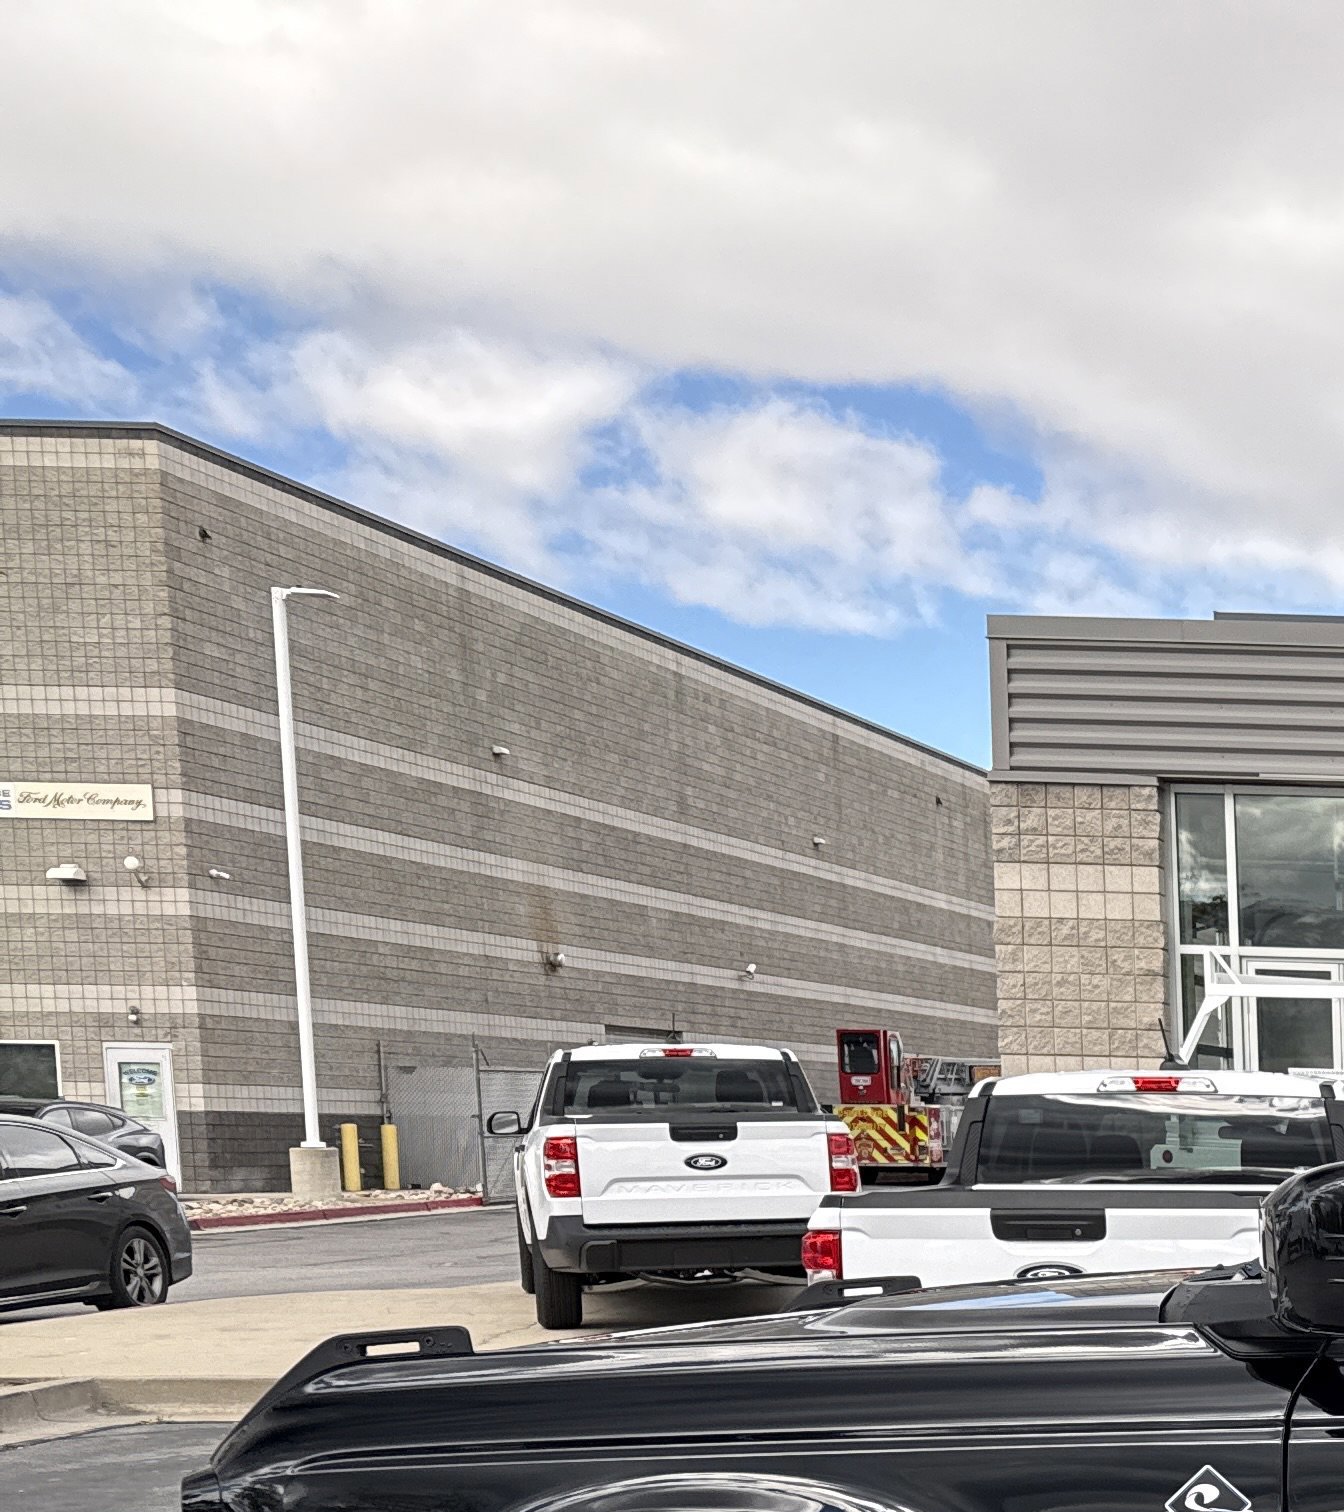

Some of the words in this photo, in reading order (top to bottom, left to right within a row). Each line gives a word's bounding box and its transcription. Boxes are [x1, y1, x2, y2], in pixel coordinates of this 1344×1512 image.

[17, 791, 49, 804] Ford
[43, 791, 84, 808] Motor
[83, 791, 147, 810] Company
[616, 1181, 794, 1194] MAVERICK
